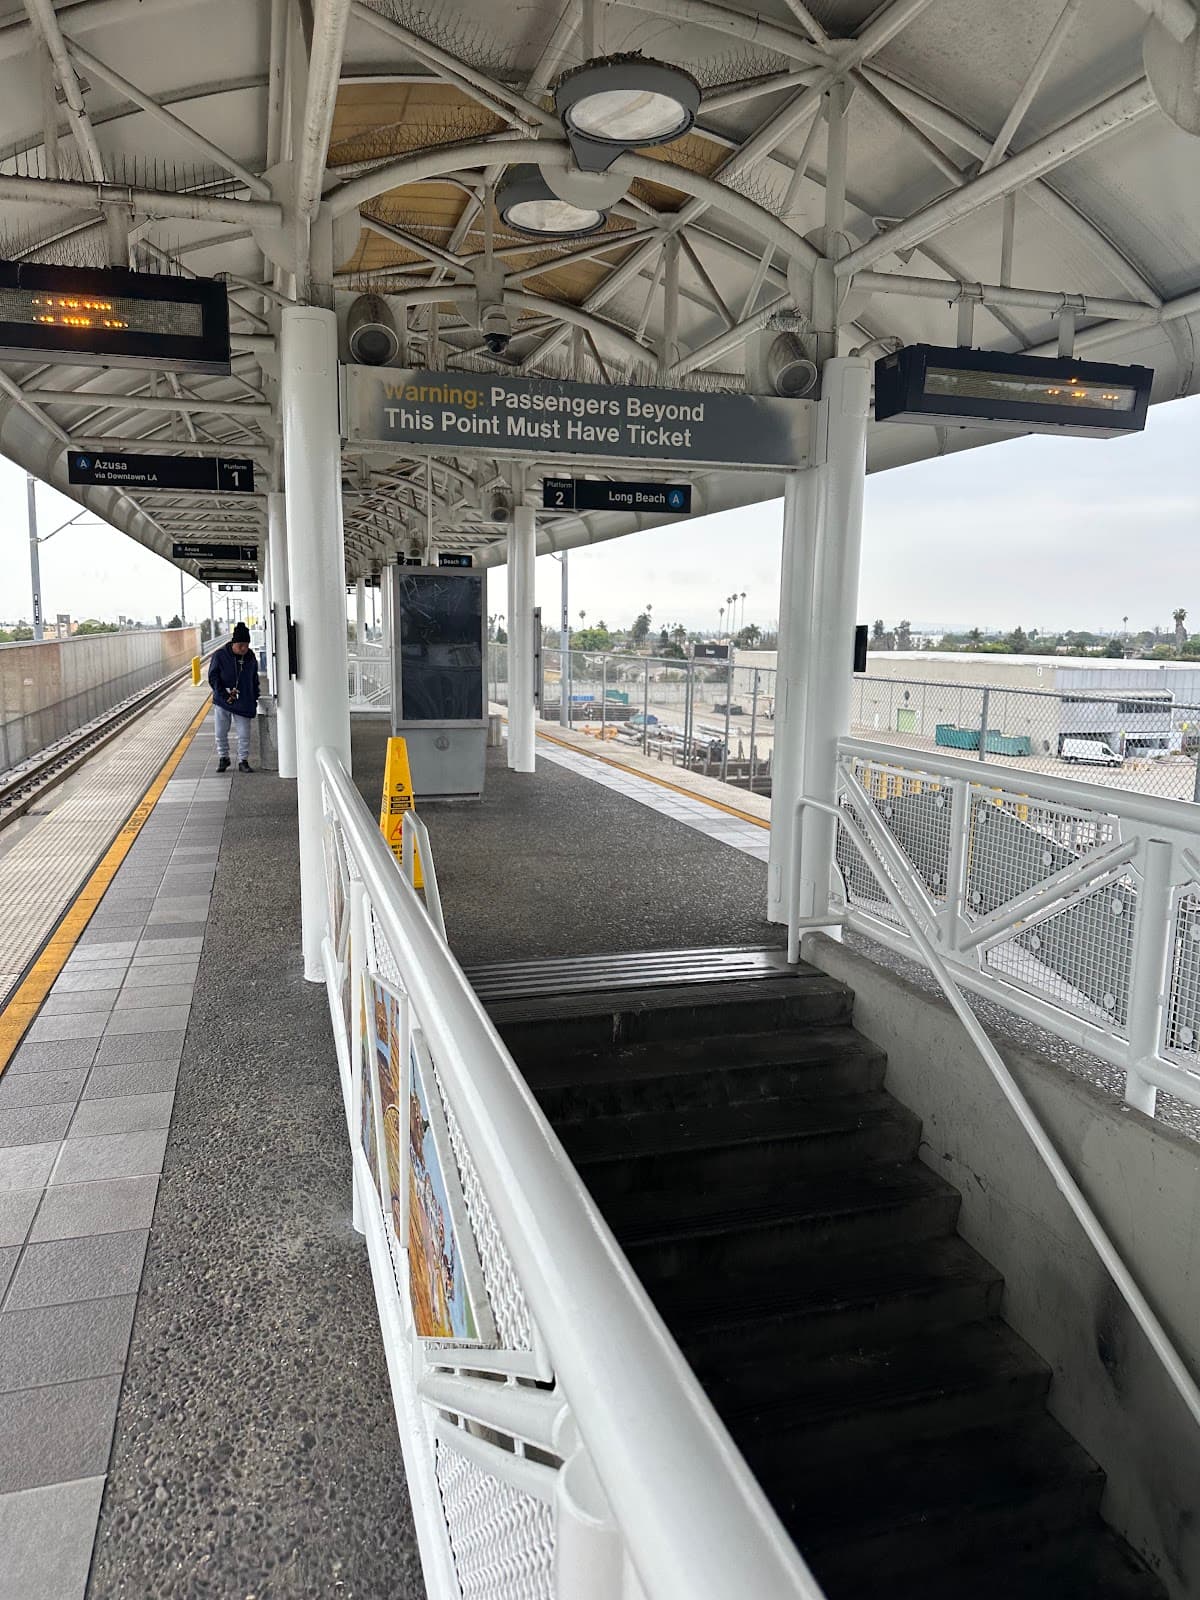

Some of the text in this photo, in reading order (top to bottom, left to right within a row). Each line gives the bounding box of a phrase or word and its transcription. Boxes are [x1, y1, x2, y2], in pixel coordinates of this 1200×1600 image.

[384, 382, 705, 423] Warning: Passengers Beyond
[383, 407, 692, 447] This Point Must Have Ticket
[80, 458, 87, 468] A
[94, 458, 128, 471] Azusa
[223, 463, 248, 471] Platform
[107, 472, 146, 481] Downtown
[147, 473, 158, 482] LA
[231, 471, 240, 487] 1
[546, 480, 573, 489] Platform
[555, 491, 564, 506] 2
[608, 491, 666, 504] Long Beach
[672, 494, 680, 504] A
